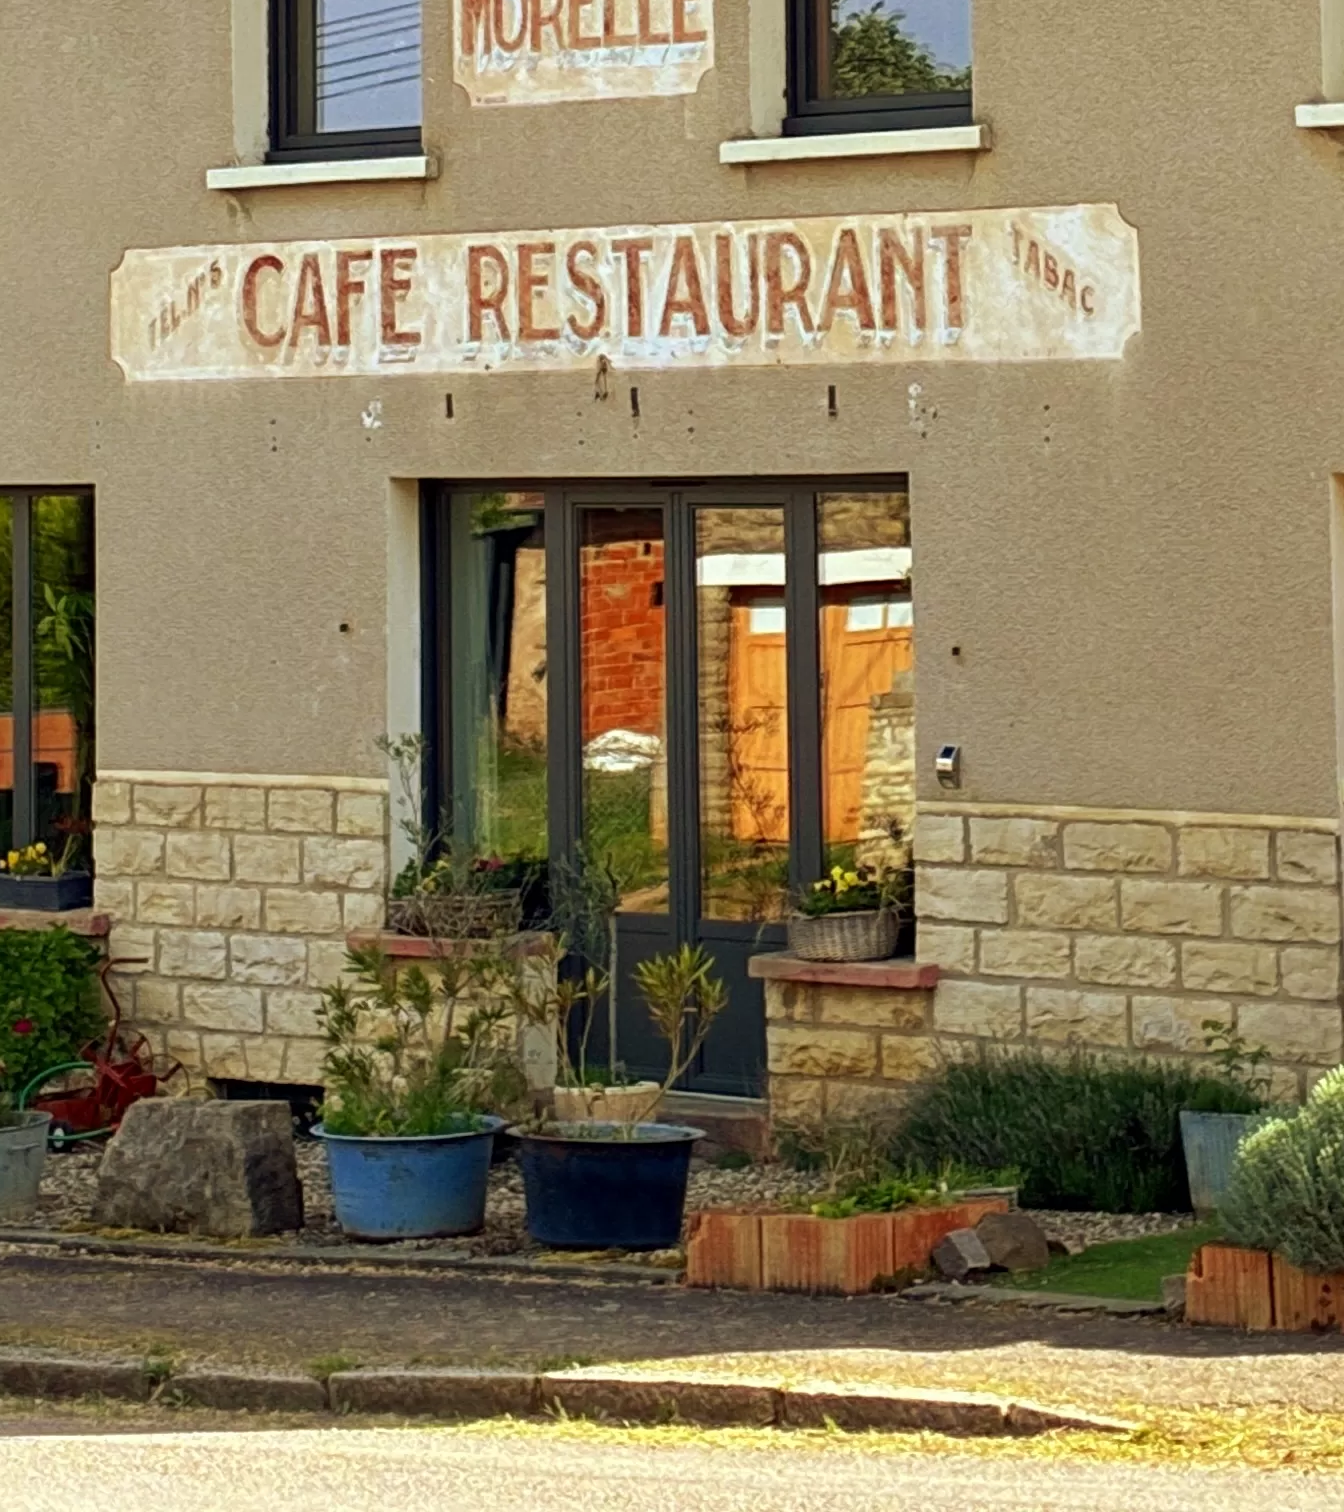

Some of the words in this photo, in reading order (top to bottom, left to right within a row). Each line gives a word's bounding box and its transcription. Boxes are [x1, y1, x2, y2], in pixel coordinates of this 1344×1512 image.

[241, 247, 422, 347] CAFE
[467, 224, 973, 343] RESTAURANT
[1010, 220, 1095, 316] TABAC
